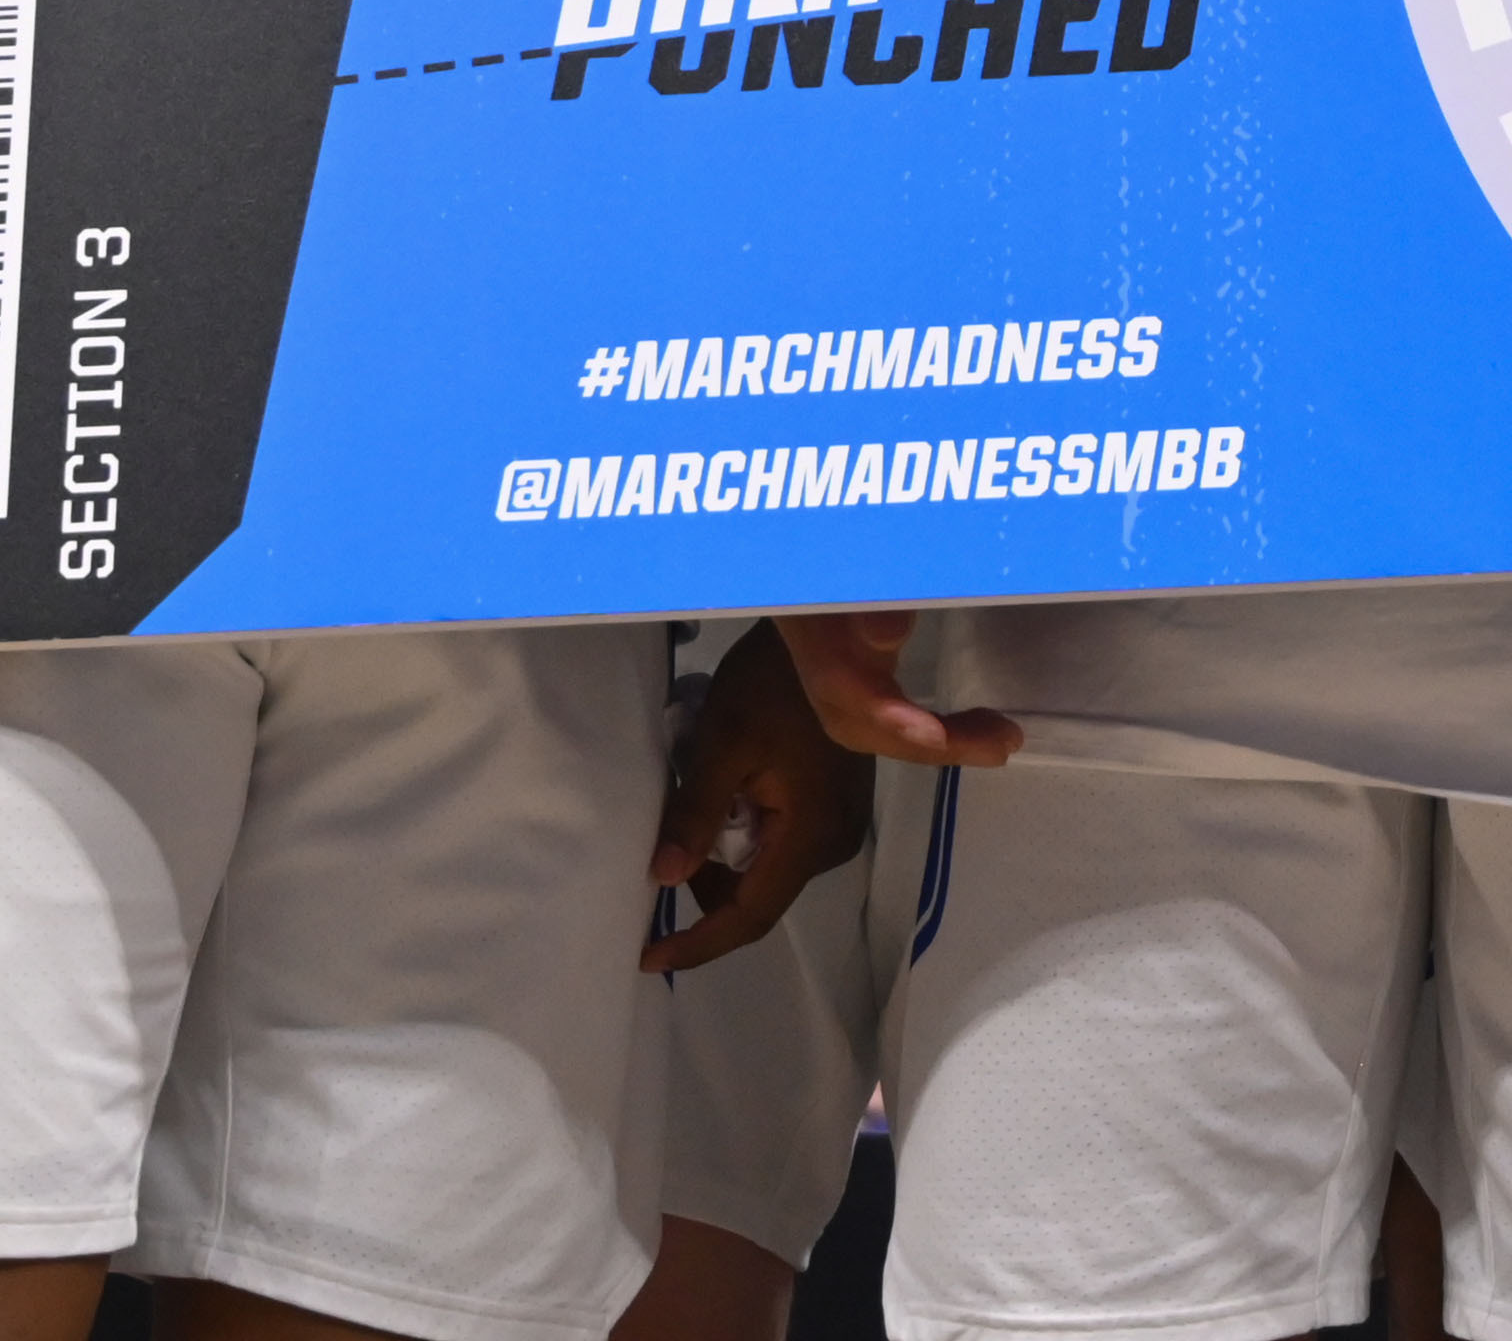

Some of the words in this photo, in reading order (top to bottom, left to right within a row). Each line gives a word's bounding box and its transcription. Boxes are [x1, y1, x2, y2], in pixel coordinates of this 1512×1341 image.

[75, 225, 131, 267] 3
[577, 315, 1163, 403] #MARCHMADNESS
[59, 289, 129, 581] SECTION
[495, 426, 1247, 523] @MARCHMADNESSMBB
